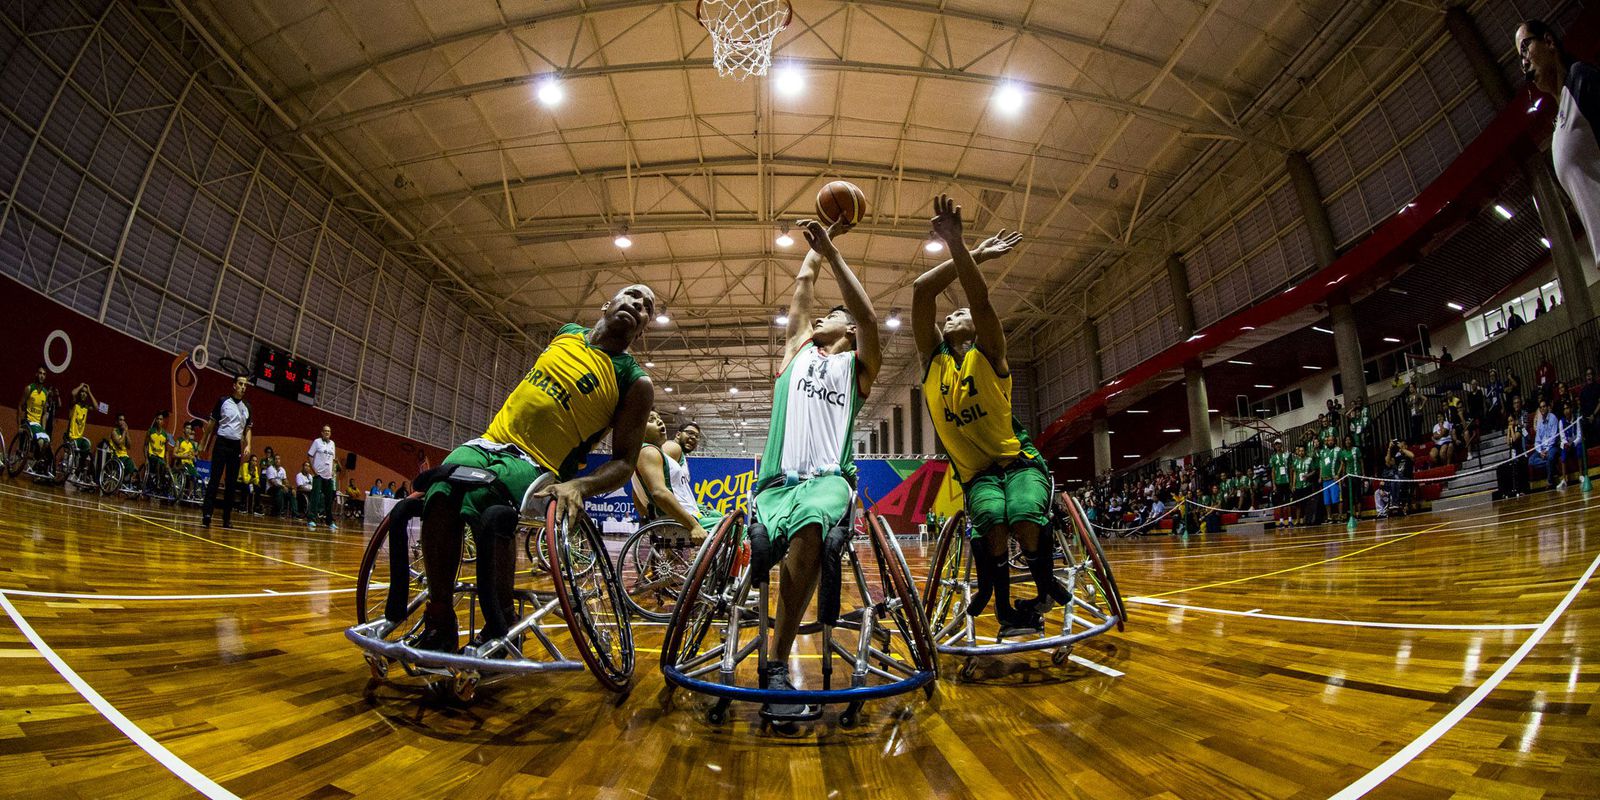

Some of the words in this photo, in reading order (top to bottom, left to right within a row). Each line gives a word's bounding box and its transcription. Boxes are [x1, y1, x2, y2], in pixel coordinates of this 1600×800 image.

[944, 403, 988, 427] BASIL
[585, 501, 614, 512] Paulo
[614, 502, 636, 514] 2017
